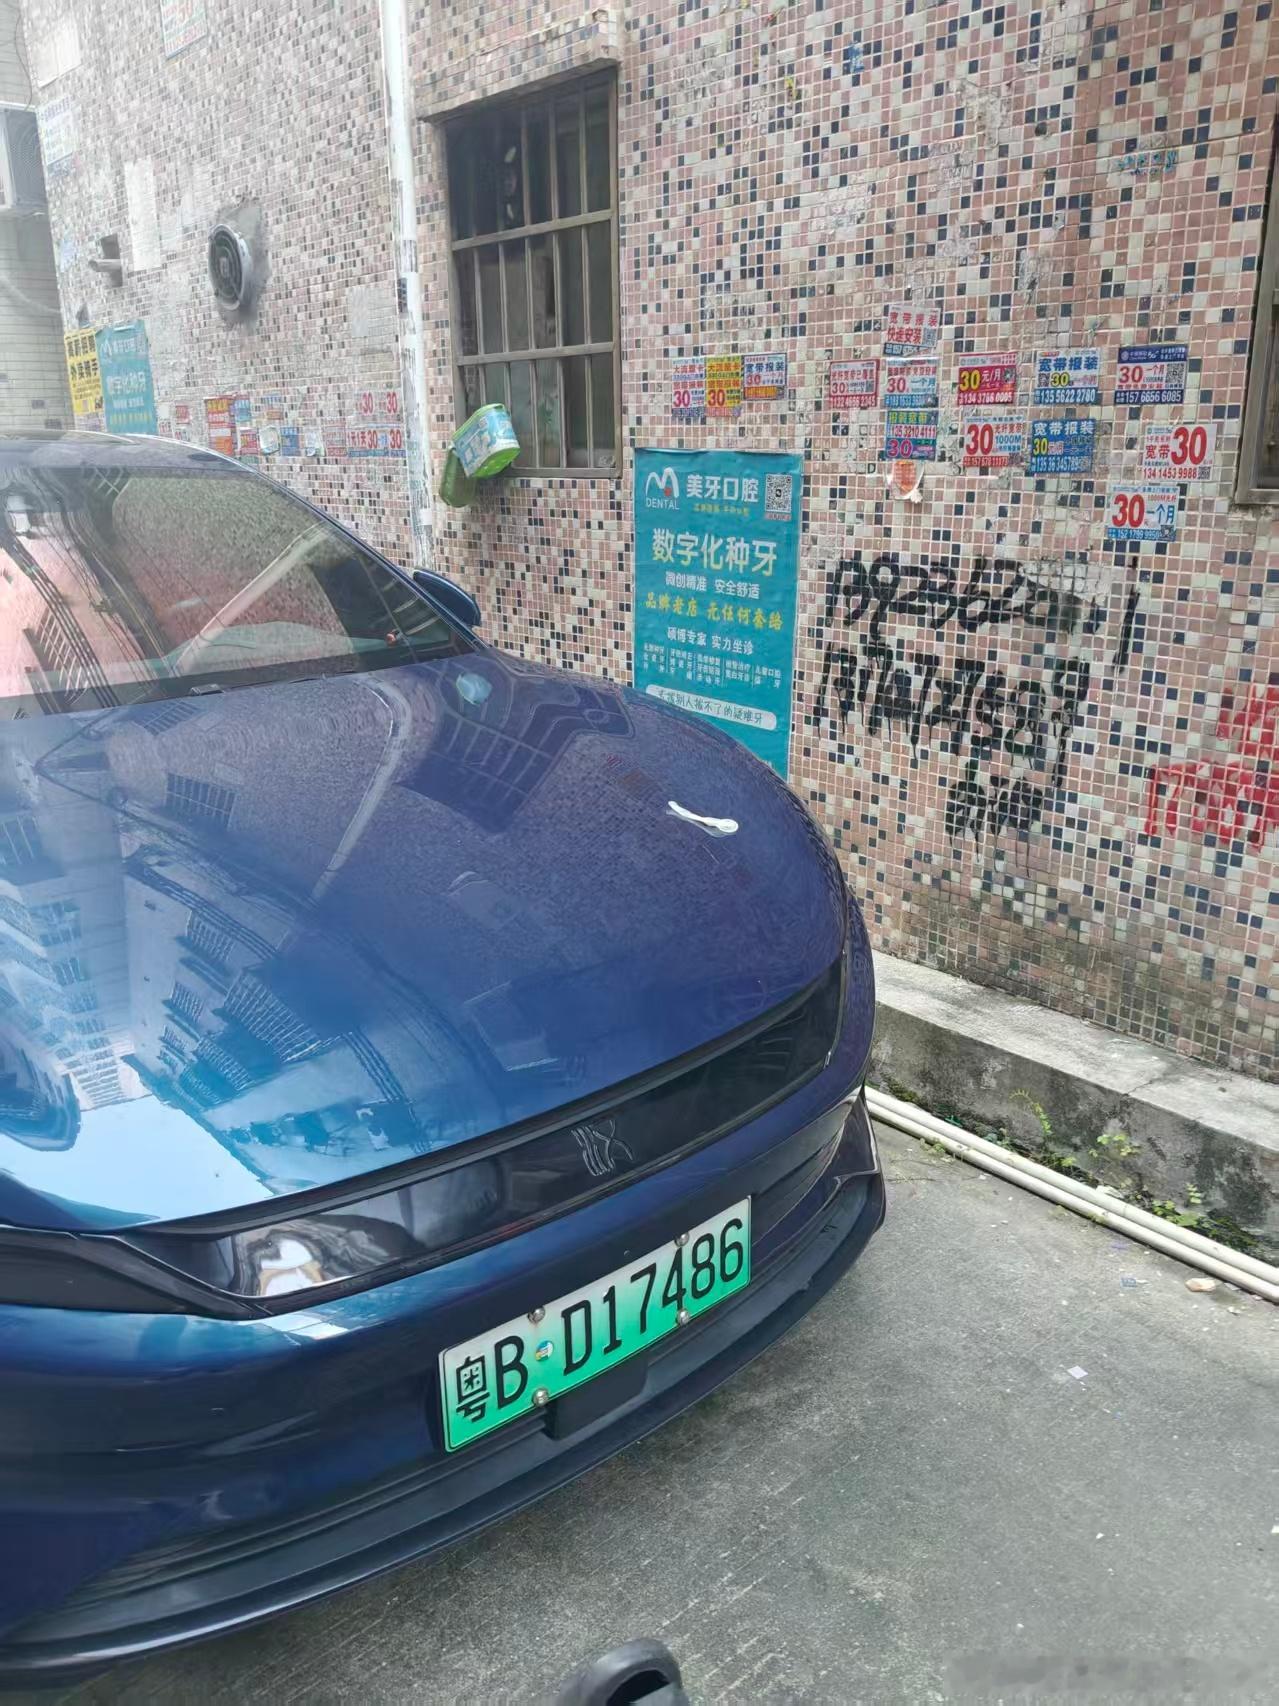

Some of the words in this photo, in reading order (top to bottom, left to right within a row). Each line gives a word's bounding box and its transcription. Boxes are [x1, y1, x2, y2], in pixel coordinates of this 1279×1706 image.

[889, 312, 939, 327] 宽带报装
[887, 327, 922, 344] 快速安装
[746, 362, 784, 373] 宽带报装
[1038, 356, 1098, 372] 宽带报装
[747, 375, 761, 386] 30
[960, 370, 981, 391] 30
[981, 368, 1002, 383] 元/月
[1051, 373, 1069, 387] 30
[1119, 366, 1143, 384] 30
[1146, 364, 1165, 376] 一个月
[832, 382, 846, 394] 30
[887, 377, 906, 393] 30
[362, 392, 373, 414] 30
[386, 392, 398, 413] 30
[674, 390, 690, 407] 30
[708, 389, 725, 406] 30
[1056, 389, 1075, 402] 5622
[1141, 391, 1160, 402] 6656
[1161, 391, 1182, 402] 6085
[1034, 421, 1094, 437] 宽带报装
[367, 430, 378, 448] 30
[389, 429, 402, 449] 30
[966, 424, 994, 455] 30
[995, 435, 1022, 445] 1000M
[1033, 438, 1047, 455] 30
[1171, 427, 1208, 465] 30
[887, 439, 913, 458] 30
[1145, 444, 1170, 460] 宽带
[1158, 468, 1176, 479] 1453
[1178, 468, 1198, 479] 9988
[686, 474, 759, 503] 美牙口腔
[646, 497, 680, 511] DENTAL
[1112, 494, 1145, 529] 30
[1146, 504, 1175, 525] 一个月
[652, 528, 778, 577] 数字化种牙
[665, 571, 708, 592] 微创精准
[714, 579, 760, 600] 安全舒适
[645, 591, 698, 617] 品牌老店
[707, 601, 783, 631] 无任何套路
[667, 626, 707, 647] 硕博专家
[711, 635, 754, 656] 实力坐诊
[455, 1334, 529, 1423] 粤B
[561, 1218, 744, 1376] D17486
